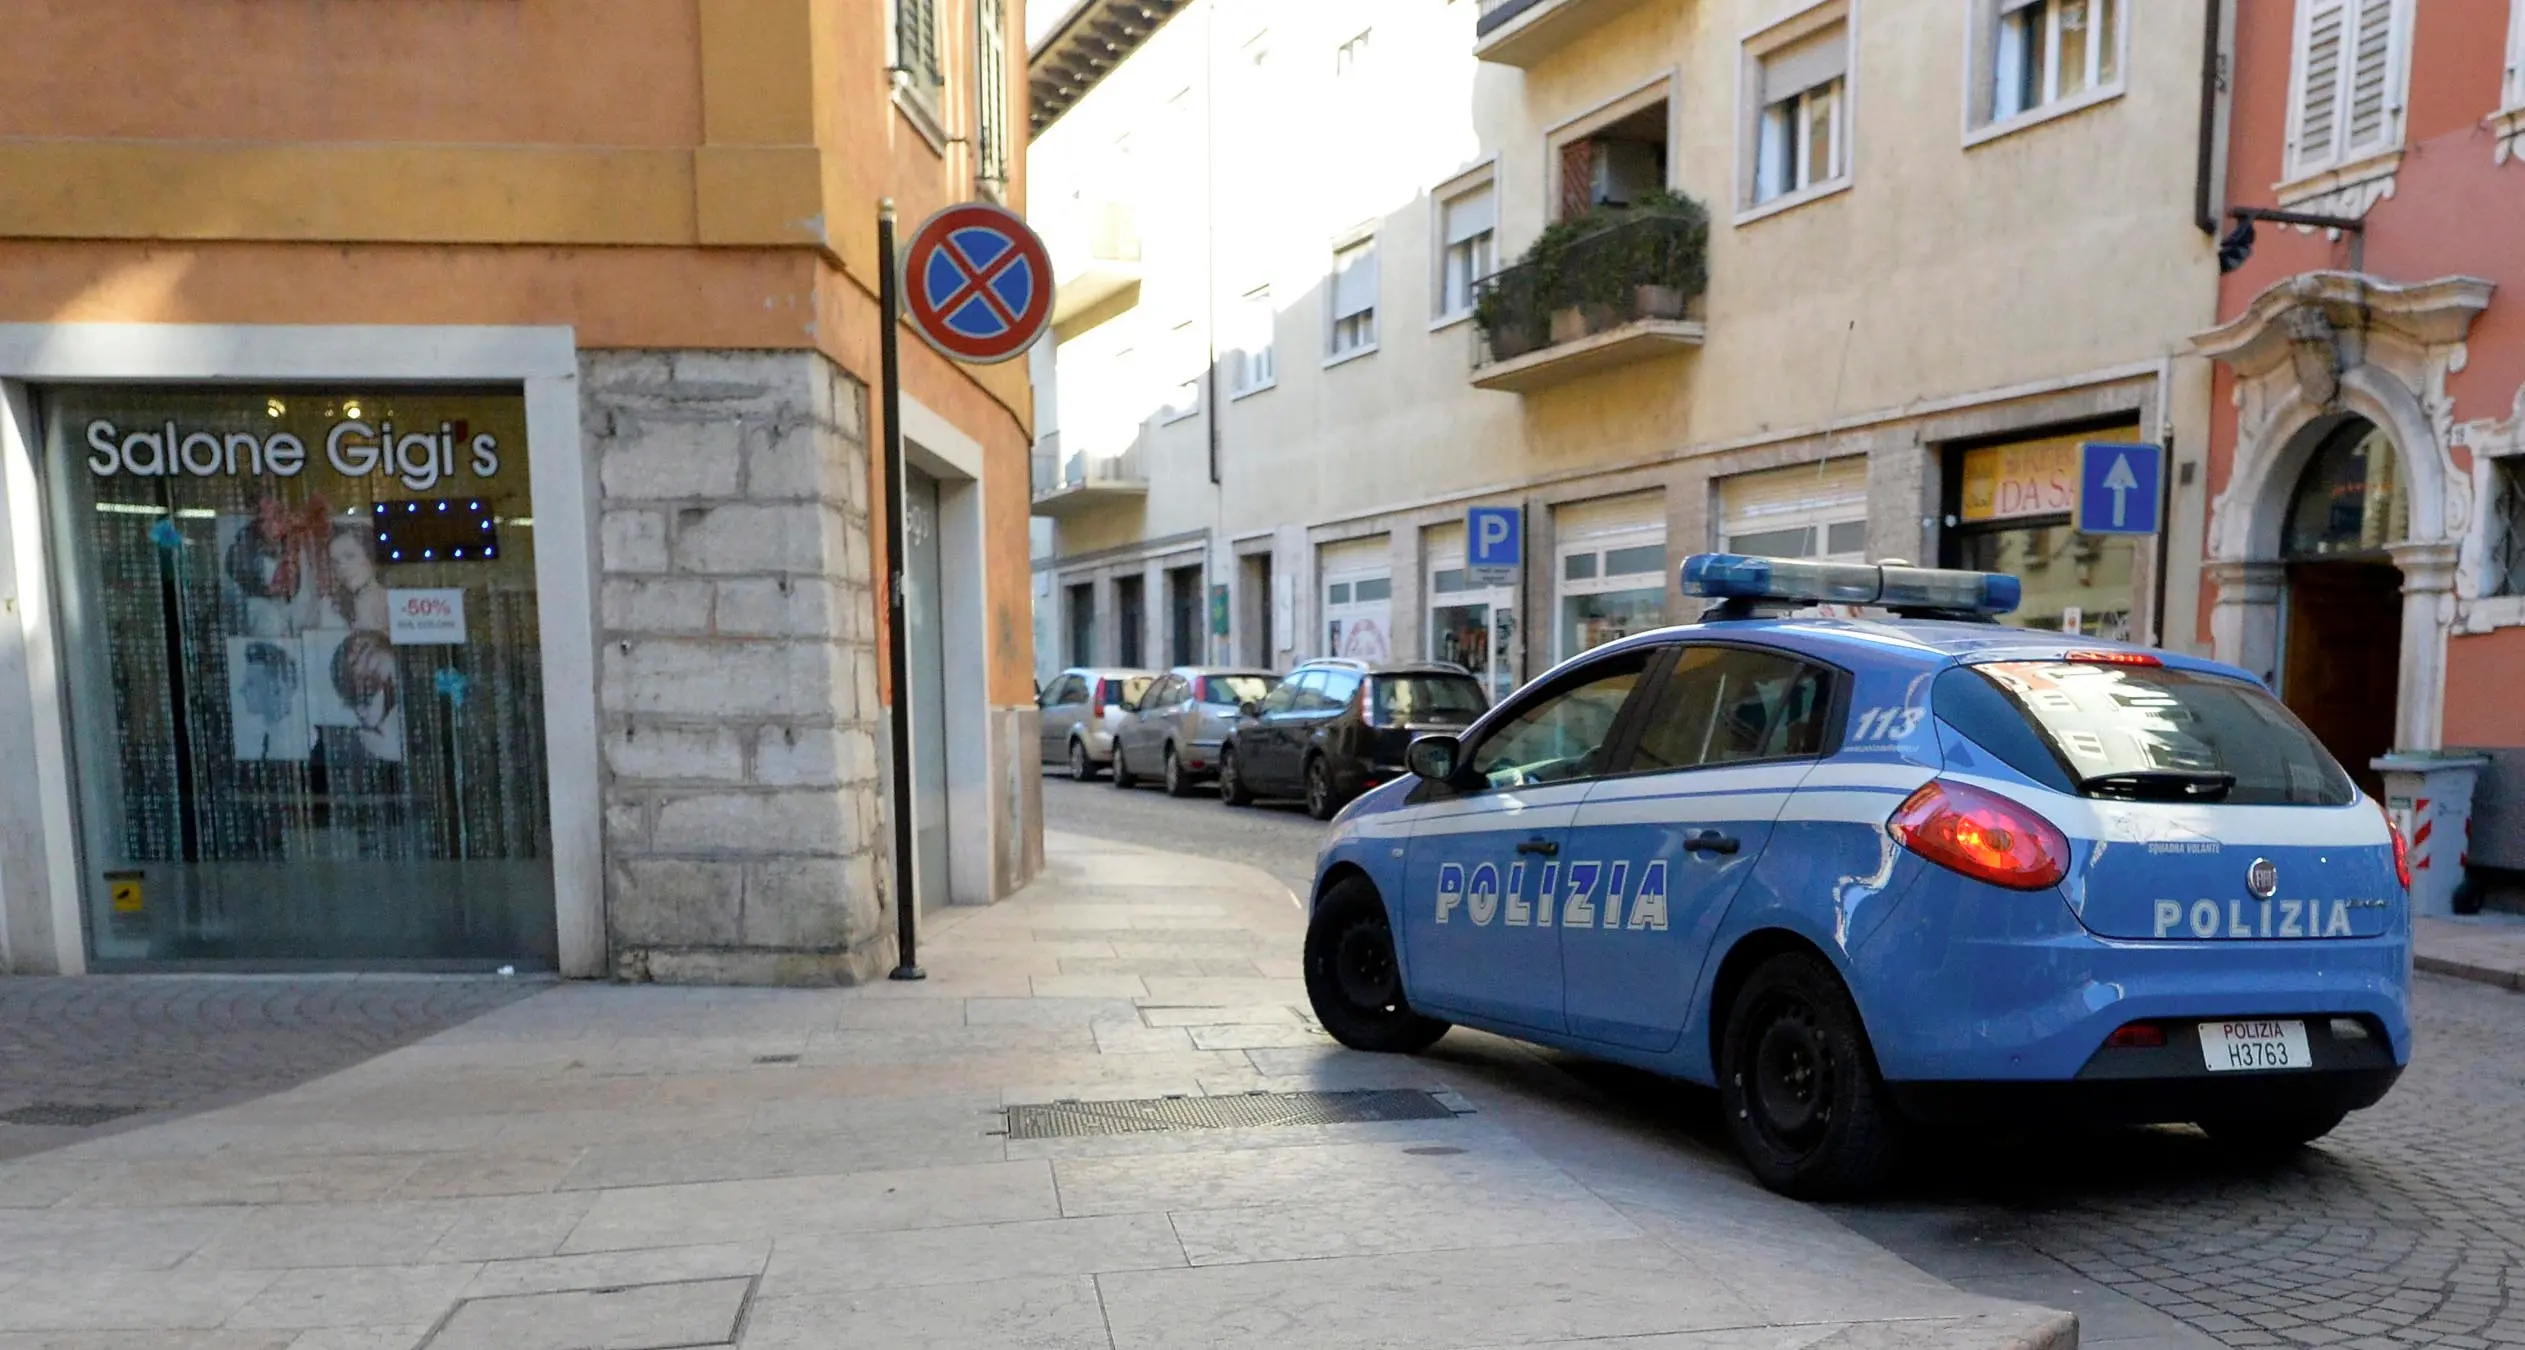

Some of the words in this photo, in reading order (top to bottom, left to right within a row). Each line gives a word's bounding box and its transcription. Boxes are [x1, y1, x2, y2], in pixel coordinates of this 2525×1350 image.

[86, 419, 306, 477] Salone
[326, 420, 500, 492] Gigi's
[2001, 476, 2040, 515] DA
[1479, 513, 1510, 559] P
[1852, 705, 1928, 741] 113
[1435, 859, 1669, 931] POLIZIA
[2153, 899, 2353, 938] POLIZIA
[2223, 1021, 2285, 1040] POLIZIA
[2228, 1042, 2288, 1067] H3763
